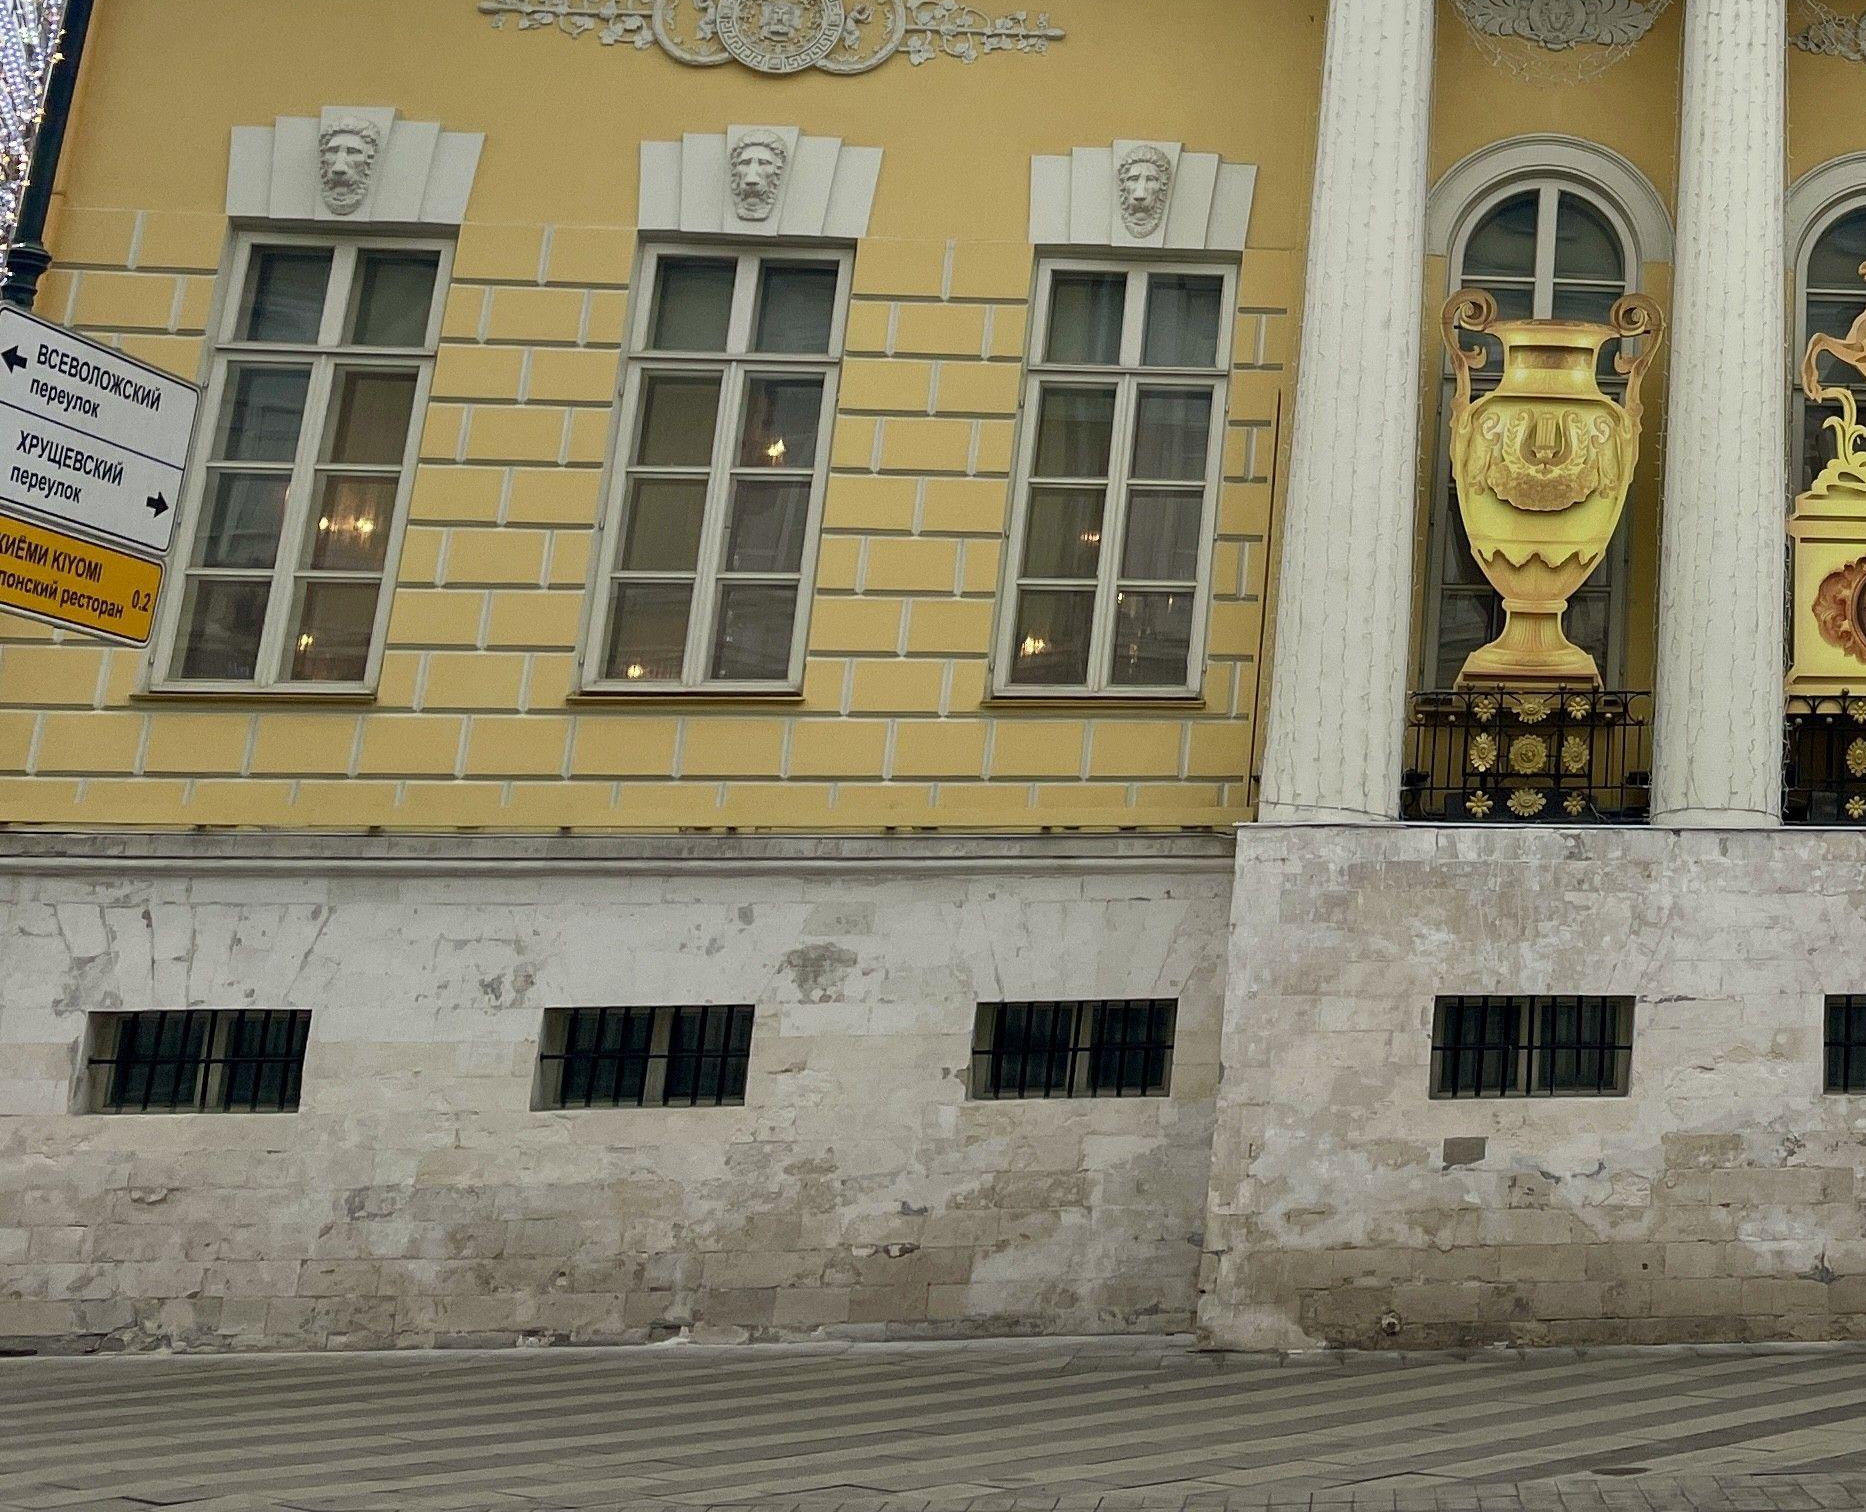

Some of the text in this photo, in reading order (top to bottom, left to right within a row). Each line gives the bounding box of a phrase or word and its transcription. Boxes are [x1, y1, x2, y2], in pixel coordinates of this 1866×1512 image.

[36, 343, 162, 412] ВСЕВОЛОЖСКИЙ
[30, 378, 100, 418] переулок
[16, 430, 124, 486] ХРУЩЕВСКИЙ
[10, 466, 82, 503] переулок
[51, 549, 103, 583] KIYOMI
[60, 588, 125, 619] ресторан
[131, 589, 152, 612] 0.2
